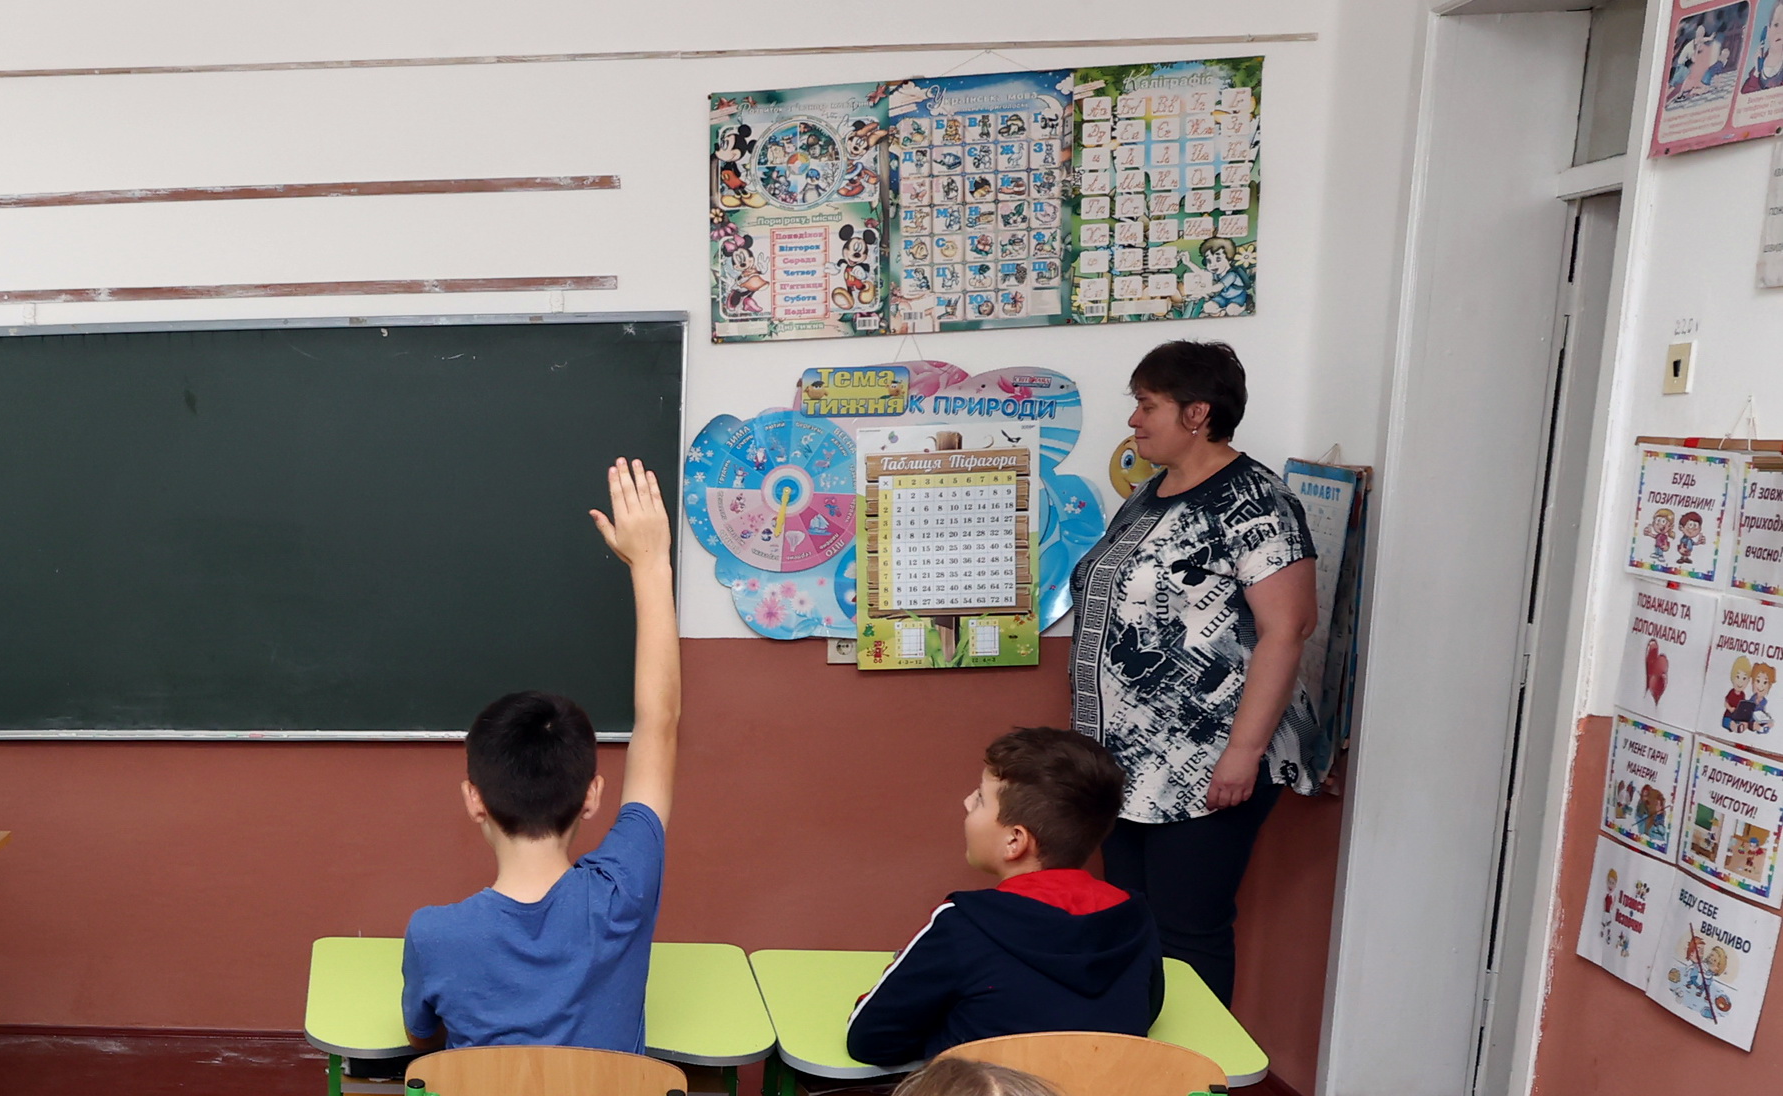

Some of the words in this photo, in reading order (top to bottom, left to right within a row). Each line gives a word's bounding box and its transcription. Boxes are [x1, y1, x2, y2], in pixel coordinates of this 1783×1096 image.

[1123, 69, 1213, 90] Каліграфія
[1006, 92, 1037, 101] мова
[936, 120, 945, 129] Б
[968, 117, 977, 127] В
[968, 147, 977, 156] Є
[1000, 145, 1014, 155] Ж
[902, 152, 914, 163] Д
[1001, 175, 1012, 187] Й
[1033, 173, 1043, 183] К
[936, 209, 948, 217] М
[969, 206, 979, 215] Н
[1034, 203, 1044, 212] П
[903, 211, 914, 220] Л
[757, 217, 781, 226] Пори
[775, 231, 823, 240] Понеділок
[969, 236, 978, 246] Т
[1033, 232, 1045, 241] Ф
[779, 244, 820, 252] Вівторок
[904, 240, 913, 249] Р
[936, 238, 946, 248] С
[783, 269, 816, 277] Четвер
[1001, 264, 1016, 273] Ш
[784, 295, 817, 303] Субота
[969, 294, 984, 304] Ю
[1001, 293, 1011, 302] Я
[816, 368, 896, 388] Тема
[803, 397, 905, 415] тижня
[932, 395, 1057, 421] ПРИРОДИ
[726, 426, 750, 448] ЗИМА
[881, 457, 942, 473] Таблиця
[949, 454, 1017, 470] Піфагора
[1672, 472, 1696, 488] БУДЬ
[1300, 481, 1341, 502] АЛФАВІТ
[1749, 482, 1757, 498] Я
[1647, 491, 1715, 511] ПОЗИТИВНИМ!
[825, 541, 845, 558] ЛІТО
[1745, 545, 1783, 563] вчасно!
[1637, 592, 1678, 617] ПОВАЖАЮ
[1680, 603, 1691, 620] ТА
[1722, 609, 1765, 632] УВАЖНО
[1632, 617, 1687, 646] ДОПОМАГАЮ
[1716, 635, 1760, 656] ДИВЛЮСЯ
[1761, 643, 1765, 657] І
[1623, 738, 1628, 749] У
[1628, 742, 1647, 757] МЕНЕ
[1647, 747, 1669, 765] ГАРНІ
[1626, 761, 1658, 782] МАНЕРИ!
[1701, 765, 1708, 777] Я
[1708, 769, 1778, 802] ДОТРИМУЮСЬ
[1710, 789, 1758, 819] ЧИСТОТИ!
[1679, 889, 1696, 909] ВЕДУ
[1697, 899, 1719, 920] СЕБЕ
[1700, 920, 1752, 954] ВВІЧЛИВО
